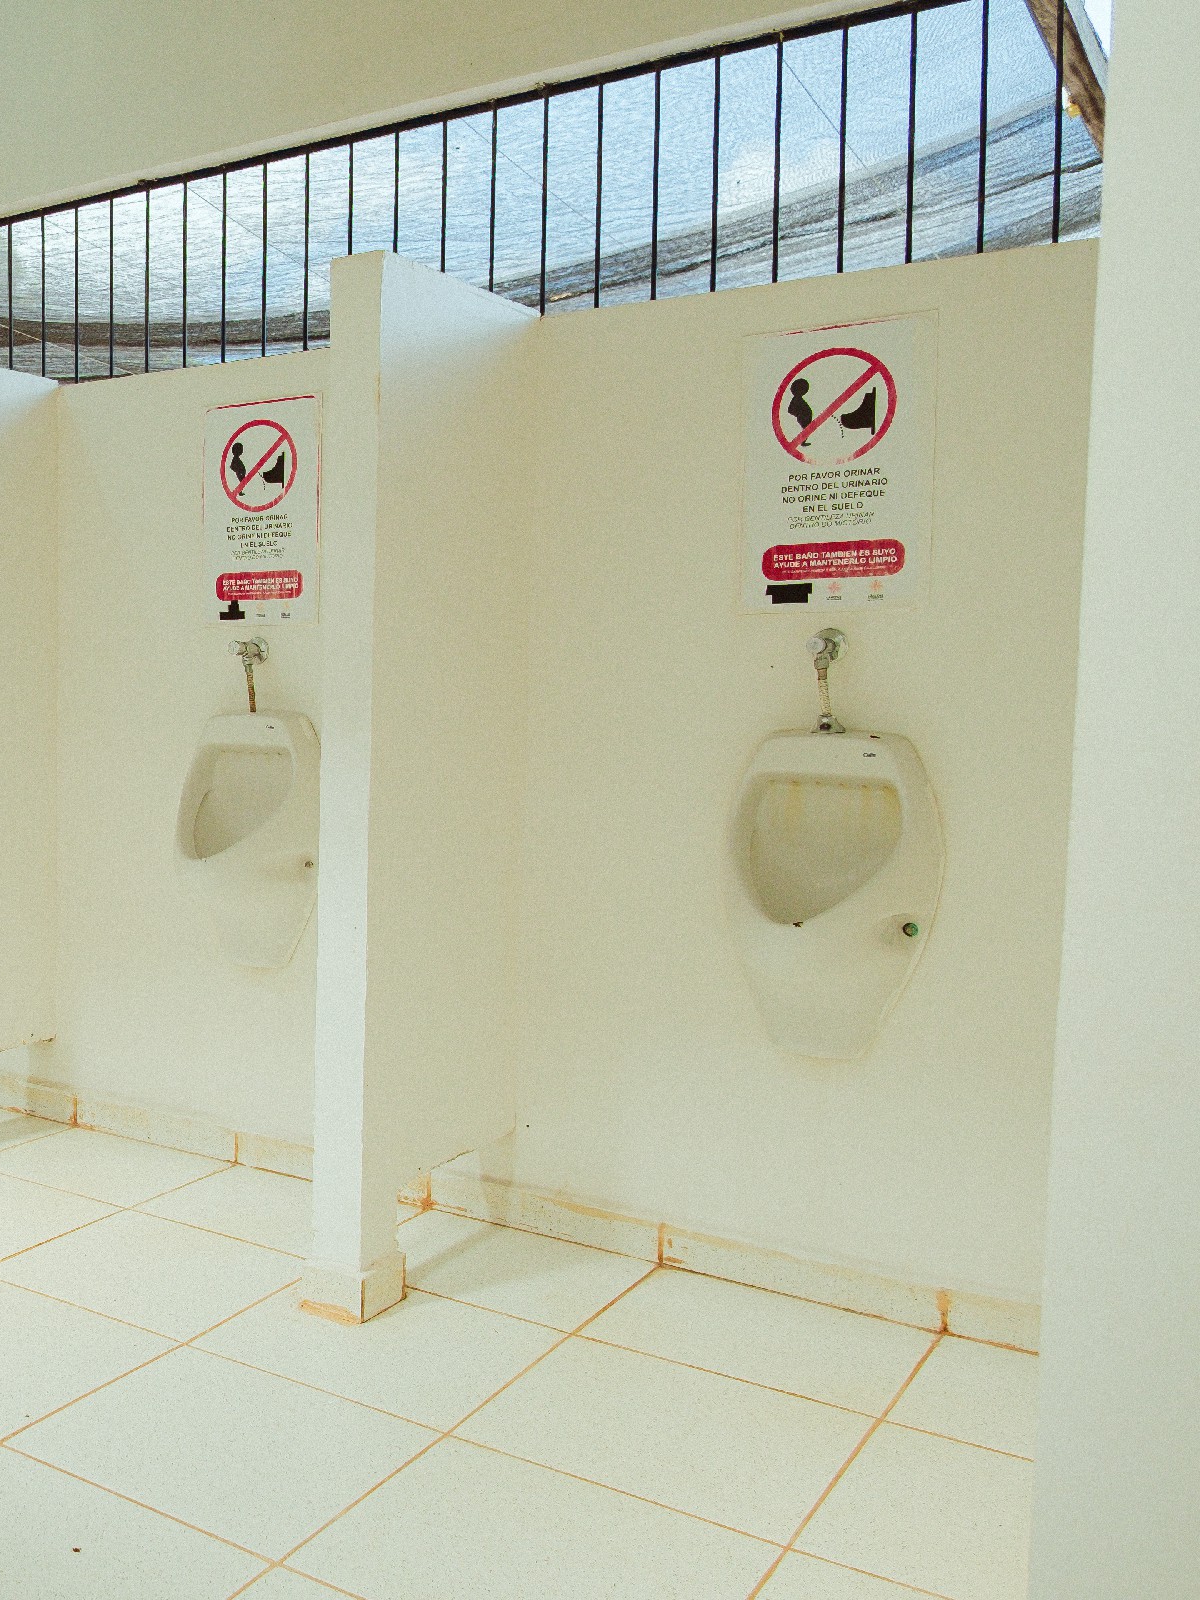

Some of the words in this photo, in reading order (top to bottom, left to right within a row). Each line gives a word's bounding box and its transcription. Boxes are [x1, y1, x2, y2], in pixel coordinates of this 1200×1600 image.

[788, 474, 808, 482] POR
[810, 470, 841, 480] FAVOR
[844, 467, 880, 478] ORINAR
[781, 483, 819, 493] DENTRO
[821, 482, 839, 490] DEL
[842, 477, 888, 489] URINARIO
[782, 496, 796, 504] NO
[797, 493, 826, 502] ORINE
[829, 492, 838, 500] NI
[840, 490, 885, 500] DEFEQUE
[802, 505, 815, 513] EN
[831, 502, 864, 511] SUELO
[773, 561, 800, 569] AYUDE
[868, 555, 898, 564] LIMPIO
